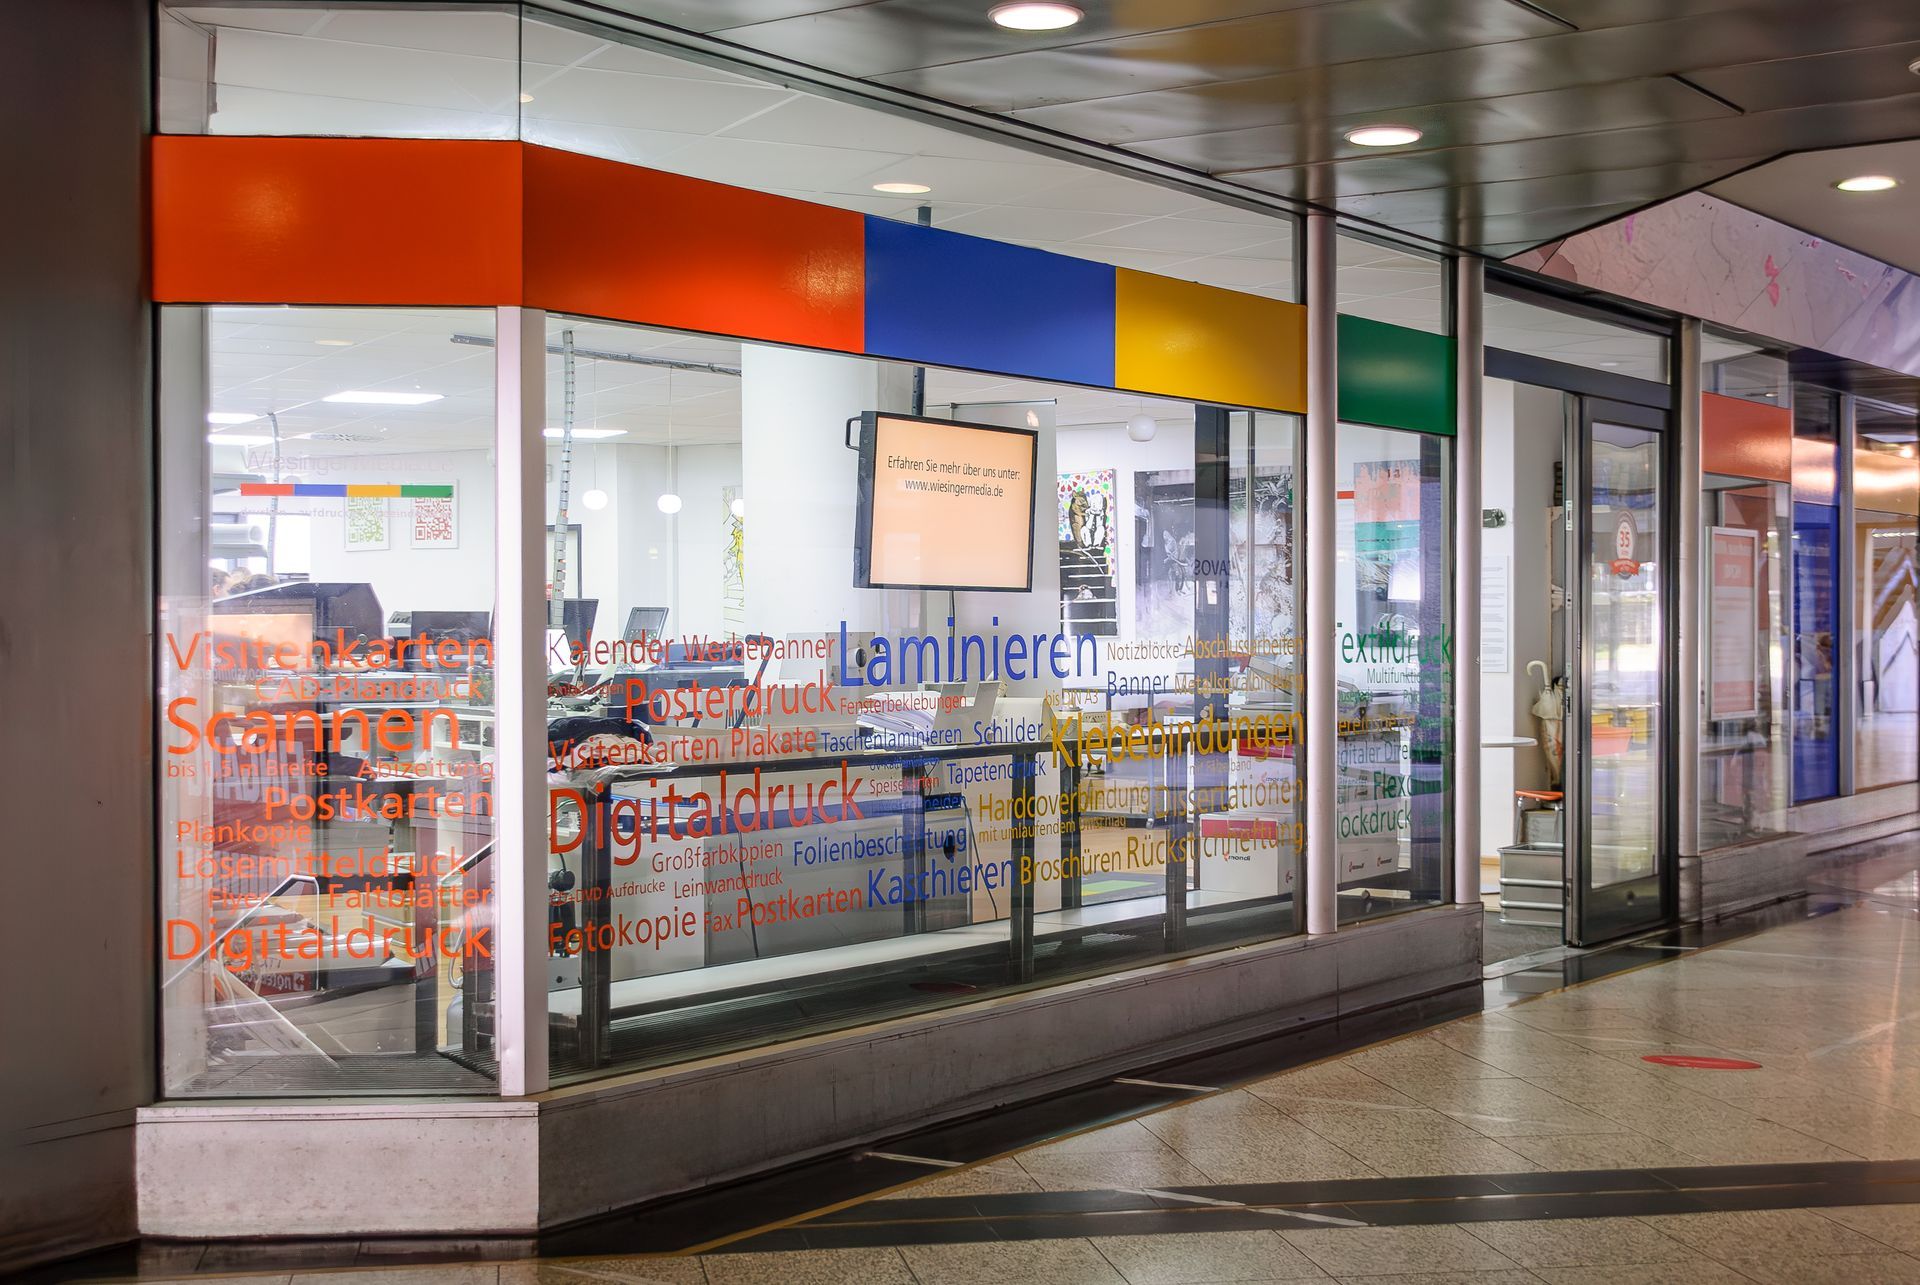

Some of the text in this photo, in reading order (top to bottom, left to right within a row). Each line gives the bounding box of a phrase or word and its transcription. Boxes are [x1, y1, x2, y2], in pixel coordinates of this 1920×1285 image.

[888, 456, 1020, 480] Erfahren Sie mehr über uns unter:
[905, 480, 1004, 497] www.wiesingermedia.de
[1620, 531, 1630, 547] 35
[167, 627, 494, 671] Visitenkarten
[548, 629, 836, 666] Kalender Werbebanner
[841, 616, 1097, 687] Laminieren
[1107, 633, 1304, 662] Notizblöcke Abschlussarbeiten
[1337, 621, 1451, 664] extildruck
[255, 674, 484, 702] CAD-Plandruck
[625, 669, 836, 723] Posterdruck
[1045, 689, 1060, 707] bis
[1085, 689, 1099, 705] A3
[1107, 671, 1169, 697] Banner
[840, 693, 967, 715] Fensterbeklebungen
[167, 696, 460, 755] Scannen
[821, 716, 1043, 753] Taschenlaminieren Schilder
[1051, 703, 1304, 769] Klebebindungen
[549, 724, 816, 772] Visitenkarten Plakate
[167, 759, 196, 778] bis
[267, 759, 328, 777] Breite
[357, 758, 494, 782] Abizeitung
[870, 775, 940, 797] Speisekarten
[948, 754, 1046, 789] Tapetendruck
[265, 782, 494, 821] Postkarten
[549, 760, 865, 866] Digitaldruck
[979, 780, 1150, 823] Hardcoverbindung
[1156, 774, 1304, 818] Dissertationen
[177, 820, 312, 847] Plankopie
[794, 827, 967, 866] Folienbeschtung
[979, 828, 997, 843] mit
[1001, 820, 1076, 841] umlaufendem
[177, 846, 469, 879] Lösemitteldruck
[652, 839, 783, 873] Großfarbkopien
[1020, 819, 1304, 885] Broschüren Rückstichheftung
[208, 881, 494, 915] Flyer Faltblätter
[606, 878, 665, 901] Aufdrucke
[674, 866, 783, 899] Leinwanddruck
[868, 855, 1014, 909] Kaschieren
[549, 885, 862, 958] Fotokopie Fax Postkarten
[166, 914, 491, 973] Digitaldruck
